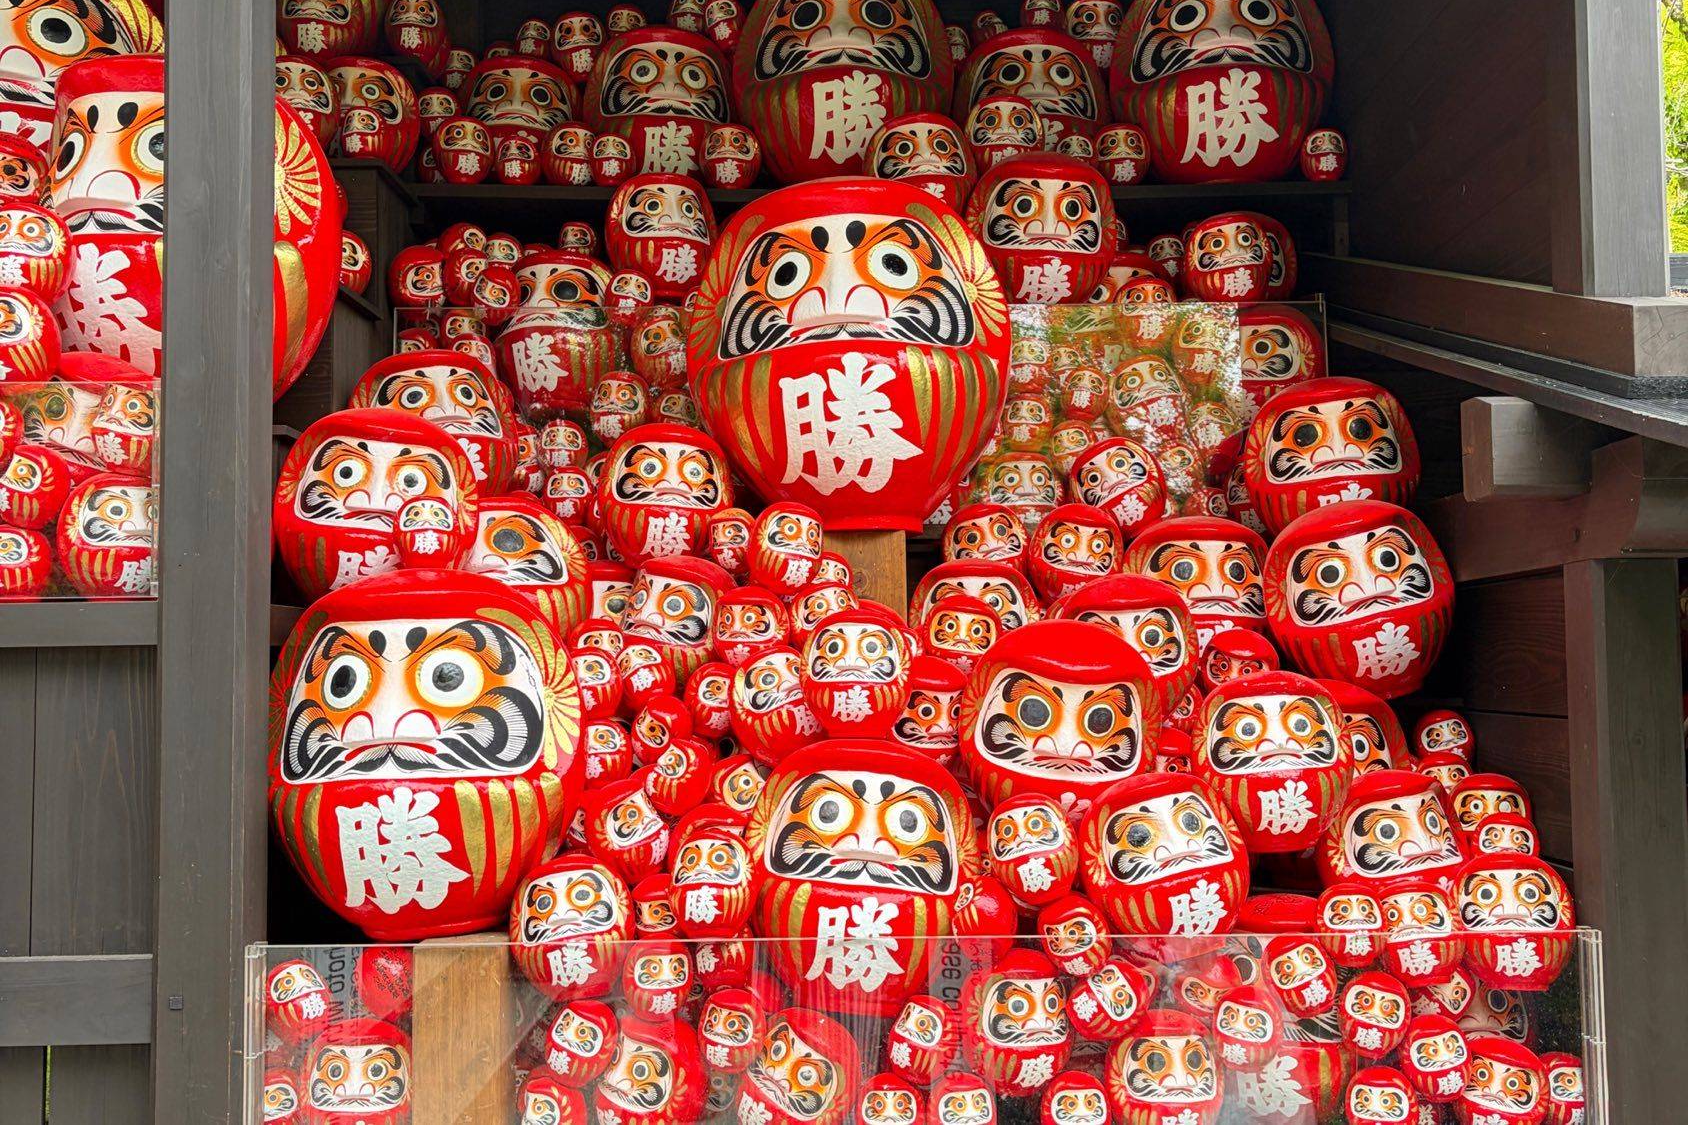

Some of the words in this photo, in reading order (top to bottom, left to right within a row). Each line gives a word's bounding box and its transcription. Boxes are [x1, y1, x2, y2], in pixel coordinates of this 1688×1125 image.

[297, 21, 327, 53] 勝
[400, 26, 423, 49] 勝
[571, 48, 594, 73] 勝
[809, 69, 887, 165] 勝
[1180, 68, 1279, 167] 勝
[455, 152, 481, 175] 勝
[642, 120, 701, 175] 勝
[1319, 153, 1338, 172] 勝
[504, 159, 523, 178] 勝
[602, 159, 621, 177] 勝
[715, 158, 741, 183] 勝
[1113, 159, 1137, 182] 勝
[656, 244, 698, 284] 勝
[1016, 258, 1072, 304] 勝
[1222, 267, 1254, 297] 勝
[512, 331, 569, 393] 勝
[778, 351, 924, 496] 勝
[96, 432, 128, 466] 勝
[1112, 493, 1149, 526] 勝
[412, 531, 440, 555] 勝
[640, 512, 691, 557] 勝
[781, 558, 812, 587] 勝
[1352, 622, 1420, 680] 勝
[631, 668, 656, 693] 勝
[831, 685, 875, 723] 勝
[1257, 779, 1317, 835] 勝
[334, 786, 471, 914] 勝
[1017, 857, 1057, 893] 勝
[685, 885, 722, 924] 勝
[1168, 879, 1228, 939] 勝
[805, 897, 905, 992] 勝
[1344, 929, 1373, 956] 勝
[1397, 939, 1440, 976] 勝
[1495, 938, 1543, 977] 勝
[547, 940, 597, 987] 勝
[649, 990, 677, 1014] 勝
[1072, 991, 1098, 1022] 勝
[1301, 979, 1330, 1007] 勝
[890, 1041, 912, 1068] 勝
[1222, 1042, 1248, 1065] 勝
[1352, 1026, 1384, 1051] 勝
[547, 1048, 571, 1075] 勝
[705, 1044, 733, 1068] 勝
[1012, 1053, 1055, 1088] 勝
[1236, 1055, 1313, 1117] 勝
[1437, 1070, 1464, 1095] 勝
